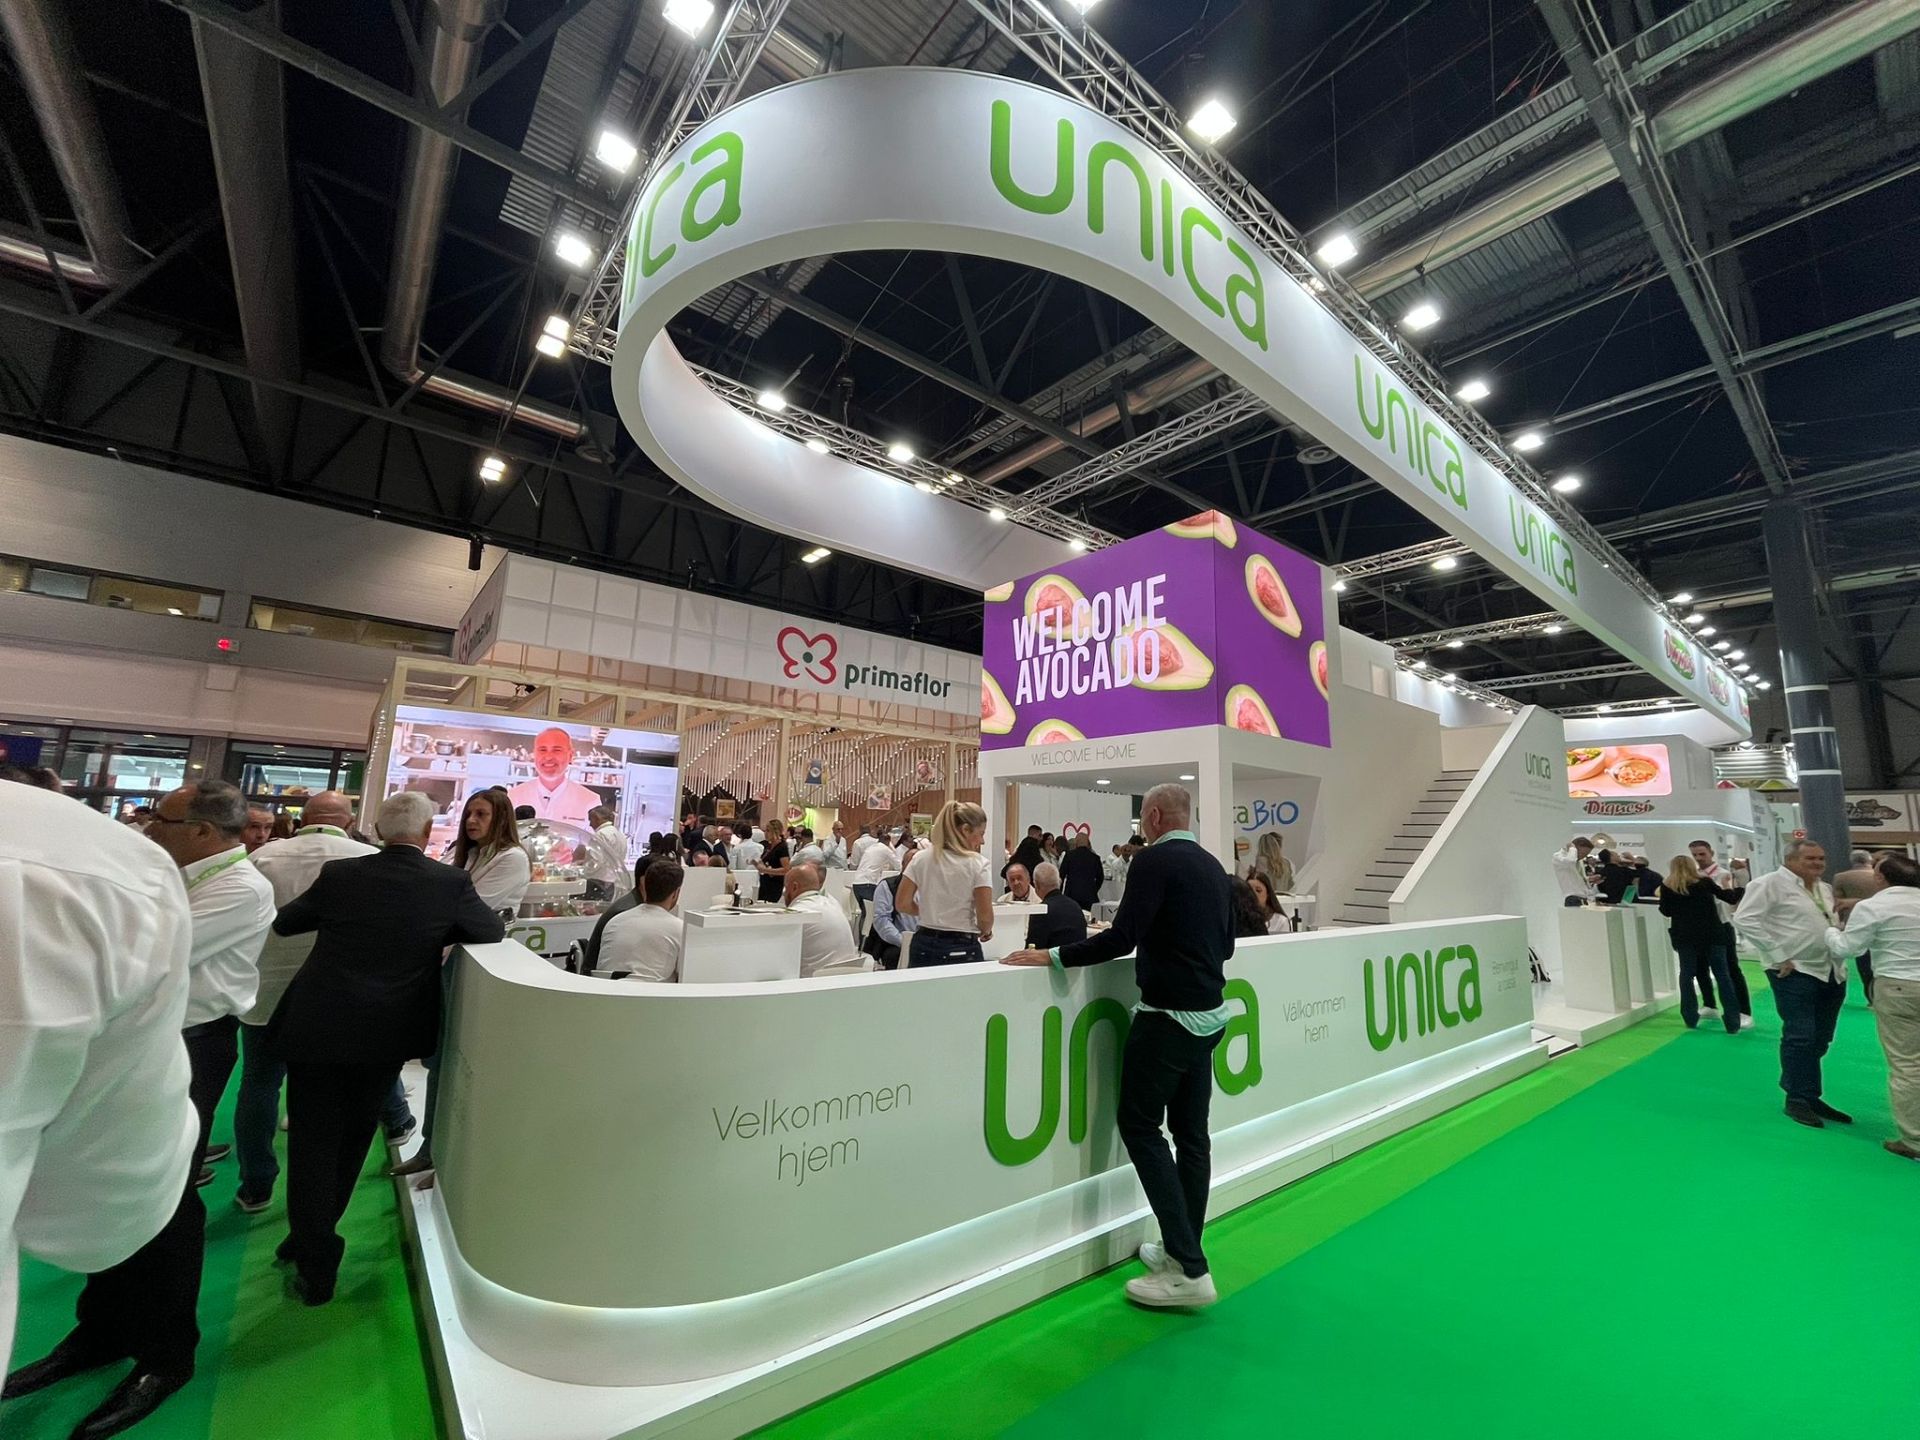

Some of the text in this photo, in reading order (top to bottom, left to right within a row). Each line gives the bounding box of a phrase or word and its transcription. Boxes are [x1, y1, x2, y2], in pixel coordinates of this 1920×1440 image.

[989, 98, 1269, 352] unica
[1354, 353, 1468, 511] unica
[1508, 494, 1578, 597] unica
[1012, 573, 1167, 661] WELCOME
[844, 663, 951, 698] primaflor
[1015, 629, 1161, 706] AVOCADO
[1031, 743, 1137, 766] WELCOME HOME
[1525, 752, 1551, 780] unica
[1304, 1024, 1330, 1044] hem
[1363, 944, 1483, 1052] unica
[984, 978, 1263, 1167] una
[712, 1083, 912, 1141] Velkommen
[776, 1138, 860, 1187] hjem
